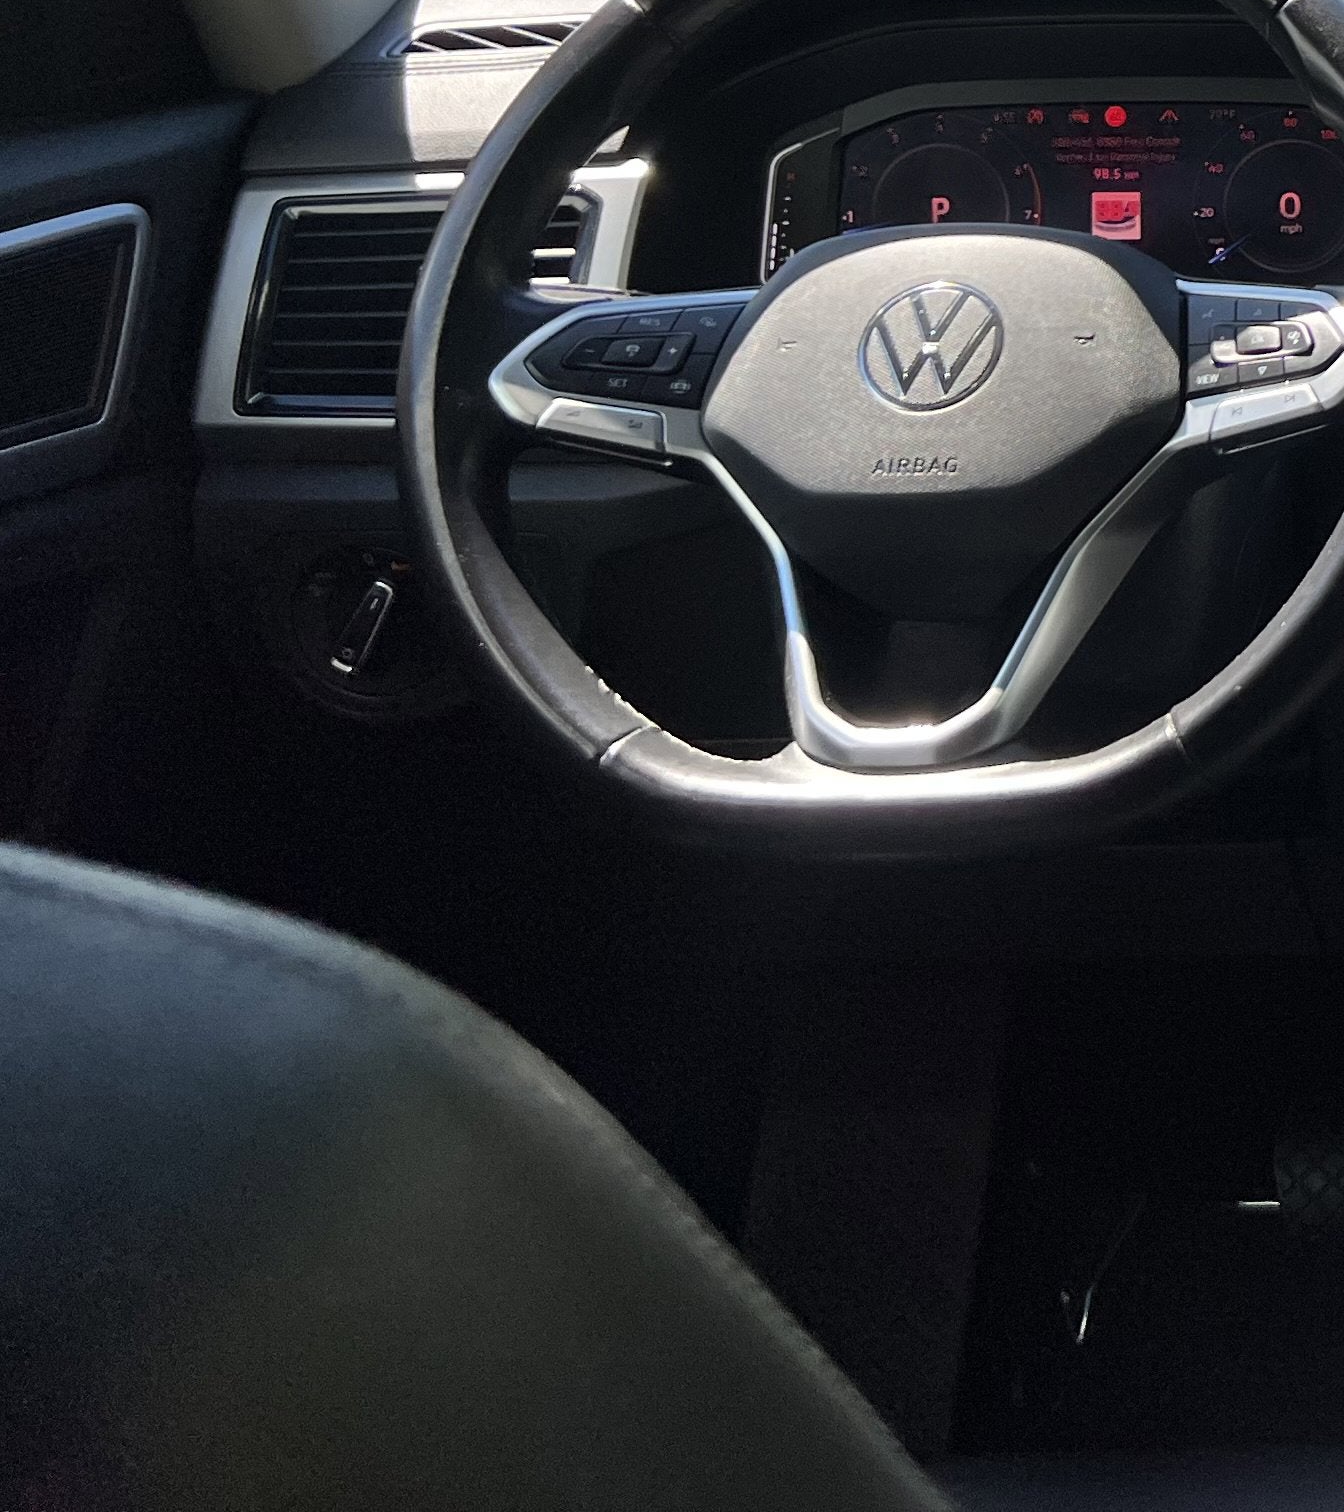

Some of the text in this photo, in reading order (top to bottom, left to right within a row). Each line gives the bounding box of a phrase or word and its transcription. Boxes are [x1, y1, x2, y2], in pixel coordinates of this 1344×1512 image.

[931, 196, 950, 223] P
[1199, 207, 1215, 218] 20
[1279, 192, 1301, 219] 0
[1280, 223, 1303, 235] mph
[872, 456, 959, 475] AIRBAG
